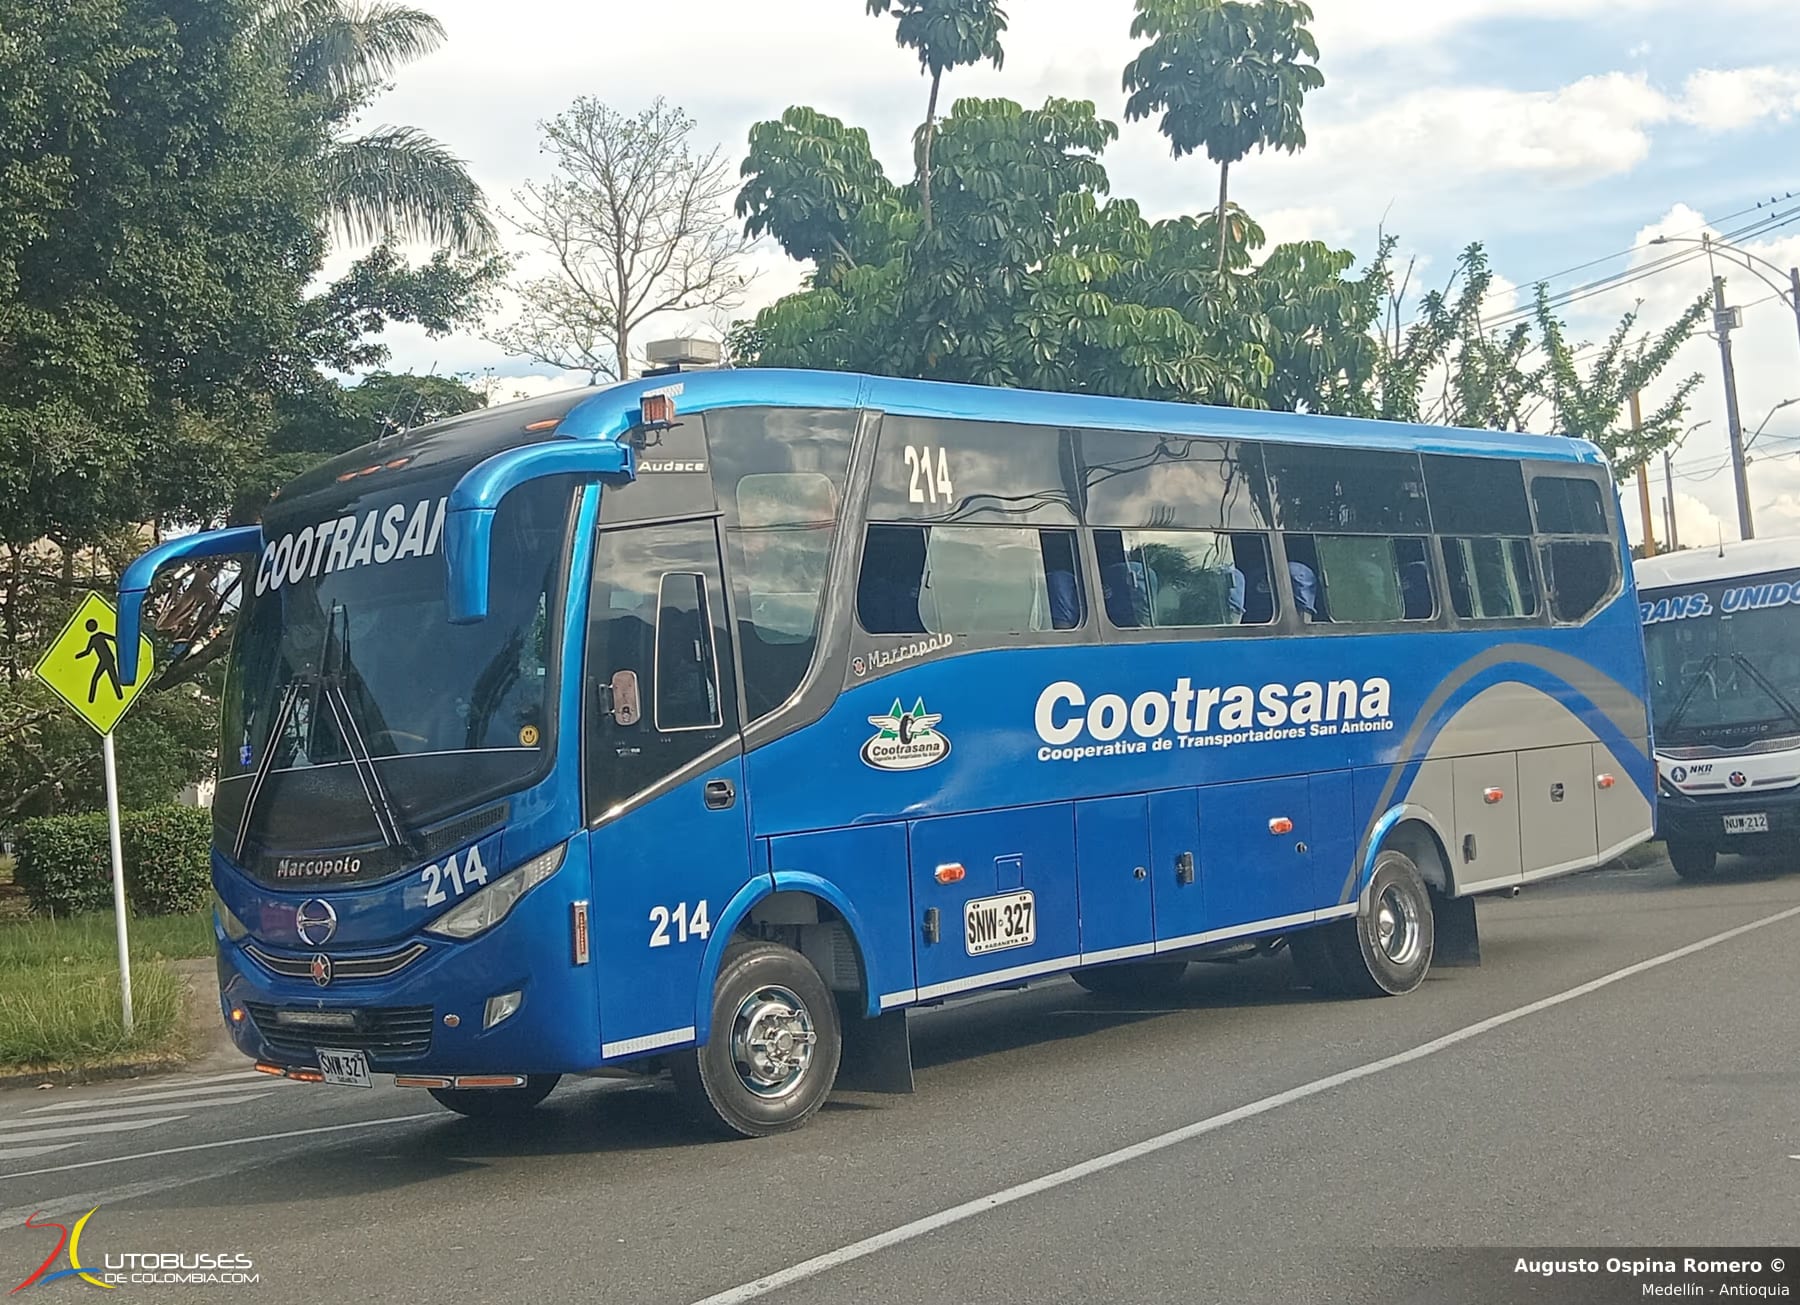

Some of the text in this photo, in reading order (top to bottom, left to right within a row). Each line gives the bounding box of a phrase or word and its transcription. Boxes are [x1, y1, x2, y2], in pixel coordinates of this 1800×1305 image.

[638, 461, 705, 472] Audace
[904, 445, 954, 504] 214
[868, 633, 953, 670] Marcopolo
[1034, 677, 1391, 745] Cootrasana
[872, 742, 940, 757] Cootrasana
[1037, 718, 1394, 762] Cooperativa de Transportadores San Antonio
[1690, 764, 1713, 774] NKR
[277, 857, 361, 878] Marcopolo
[421, 846, 488, 908] 214
[649, 901, 710, 948] 214
